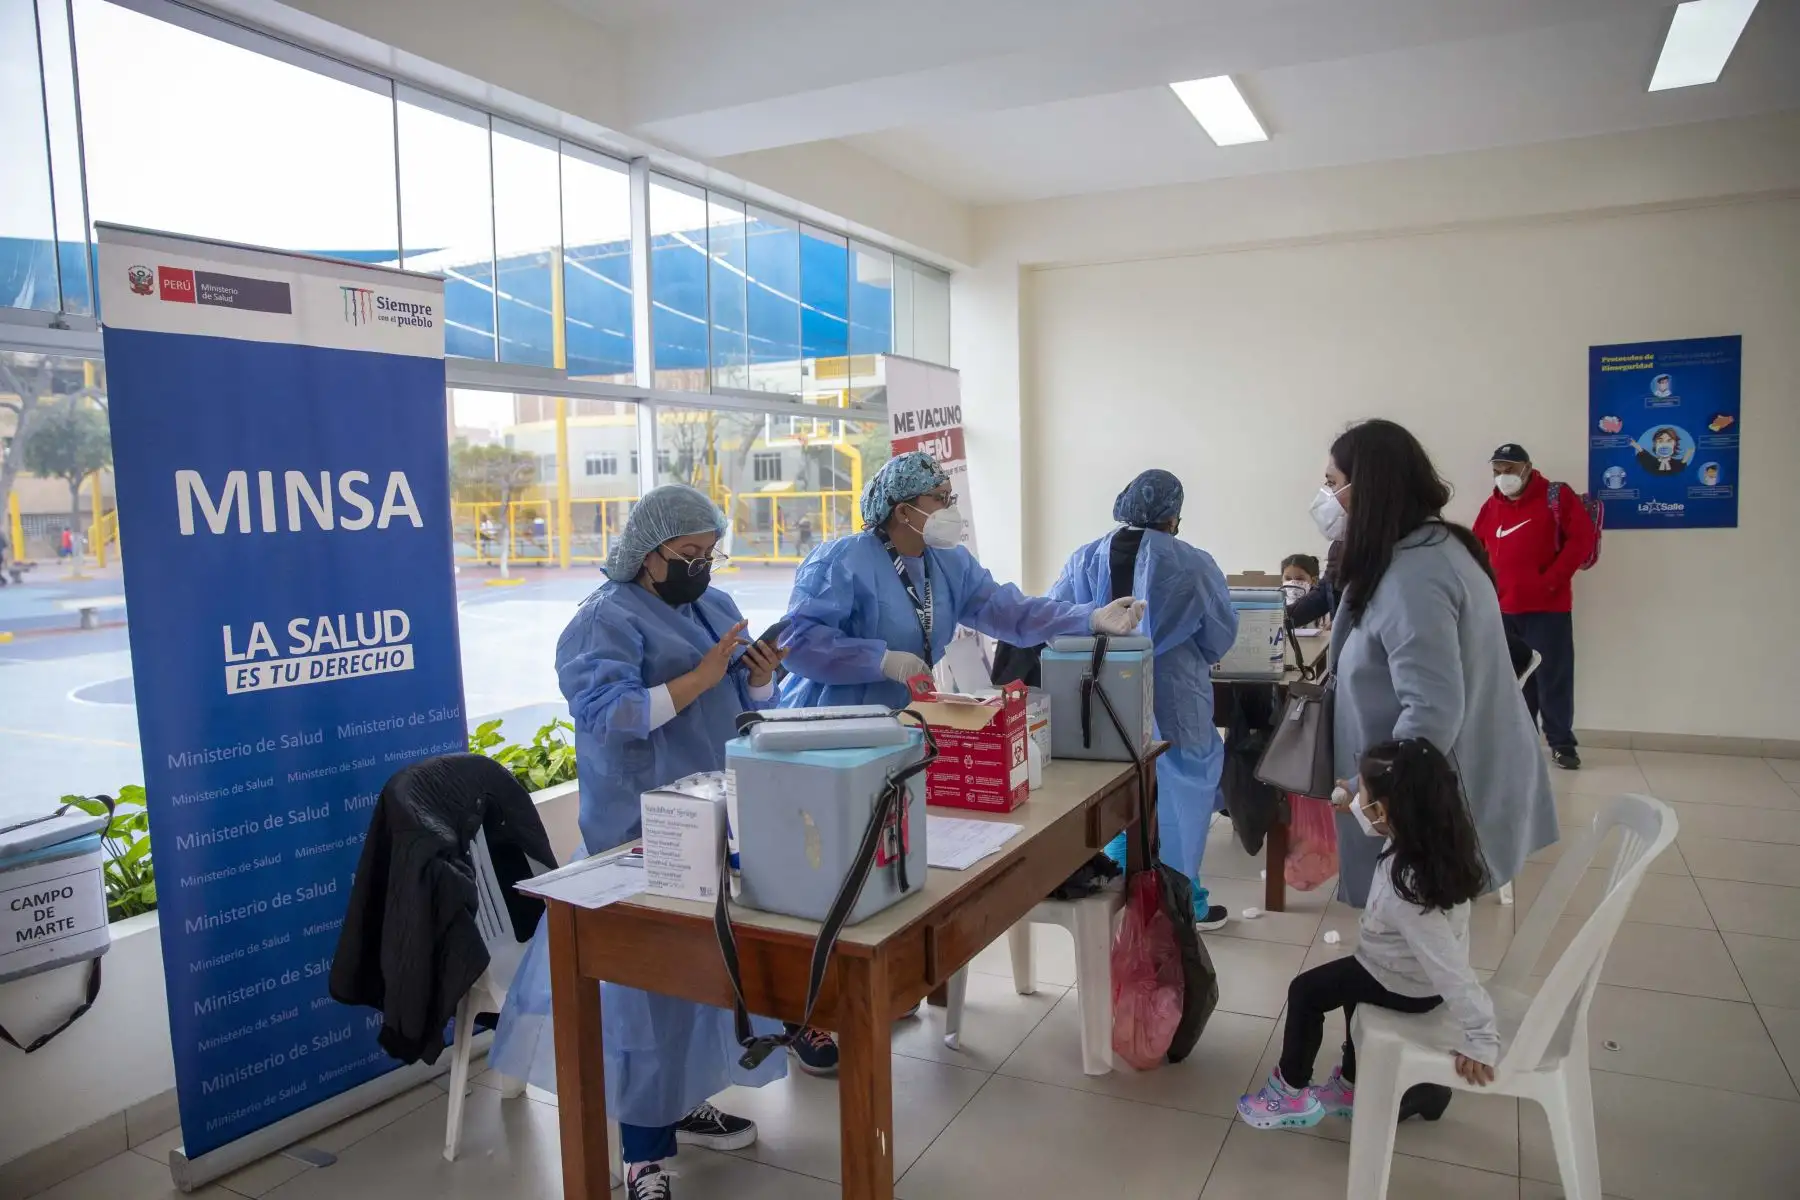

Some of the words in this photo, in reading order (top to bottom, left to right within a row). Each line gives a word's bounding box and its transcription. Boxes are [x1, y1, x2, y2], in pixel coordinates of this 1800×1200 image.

[163, 279, 191, 291] PERÚ
[201, 283, 238, 295] Ministerio
[202, 291, 212, 300] de
[213, 293, 233, 302] Salud
[377, 296, 432, 317] Siempre
[398, 315, 433, 328] pueblo
[894, 411, 915, 434] ME
[916, 405, 962, 430] VACUNO
[175, 470, 424, 535] MINSA
[1638, 503, 1649, 512] La
[1660, 503, 1685, 511] Salle
[223, 621, 279, 662] LA
[287, 609, 411, 655] SALUD
[236, 667, 260, 689] ES
[270, 662, 300, 684] TU
[309, 650, 405, 679] DERECHO
[337, 715, 404, 740] Ministerio
[408, 712, 425, 726] de
[428, 704, 460, 723] Salud
[168, 742, 252, 769] Ministerio
[256, 737, 276, 753] de
[280, 728, 323, 749] Salud
[384, 747, 428, 762] Ministerio
[430, 743, 441, 753] de
[443, 740, 463, 752] Salud
[287, 765, 337, 783] Ministerio
[339, 763, 351, 773] de
[352, 755, 376, 770] Salud
[172, 786, 229, 807] Ministerio
[231, 783, 243, 794] de
[246, 776, 274, 791] Salud
[176, 820, 259, 851] Ministerio
[263, 814, 283, 830] de
[288, 802, 329, 824] Salud
[295, 839, 344, 859] Ministerio
[346, 835, 357, 846] de
[180, 866, 236, 888] Ministerio
[238, 863, 251, 873] de
[253, 853, 282, 870] Salud
[11, 886, 74, 911] CAMPO
[34, 906, 55, 922] DE
[185, 899, 267, 935] Ministerio
[272, 892, 292, 908] de
[296, 878, 337, 902] Salud
[16, 916, 75, 943] MARTE
[189, 948, 245, 974] Ministerio
[247, 943, 259, 954] de
[261, 932, 291, 950] Salud
[193, 977, 276, 1017] Ministerio
[280, 969, 300, 985] de
[198, 1024, 253, 1052] Ministerio
[255, 1019, 269, 1030] de
[270, 1006, 299, 1025] Salud
[202, 1053, 285, 1095] Ministerio
[289, 1042, 308, 1060] de
[312, 1024, 351, 1051] Salud
[318, 1057, 366, 1084] Ministerio
[367, 1051, 381, 1064] de
[207, 1101, 261, 1132] Ministerio
[263, 1094, 277, 1106] de
[279, 1080, 307, 1100] Salud
